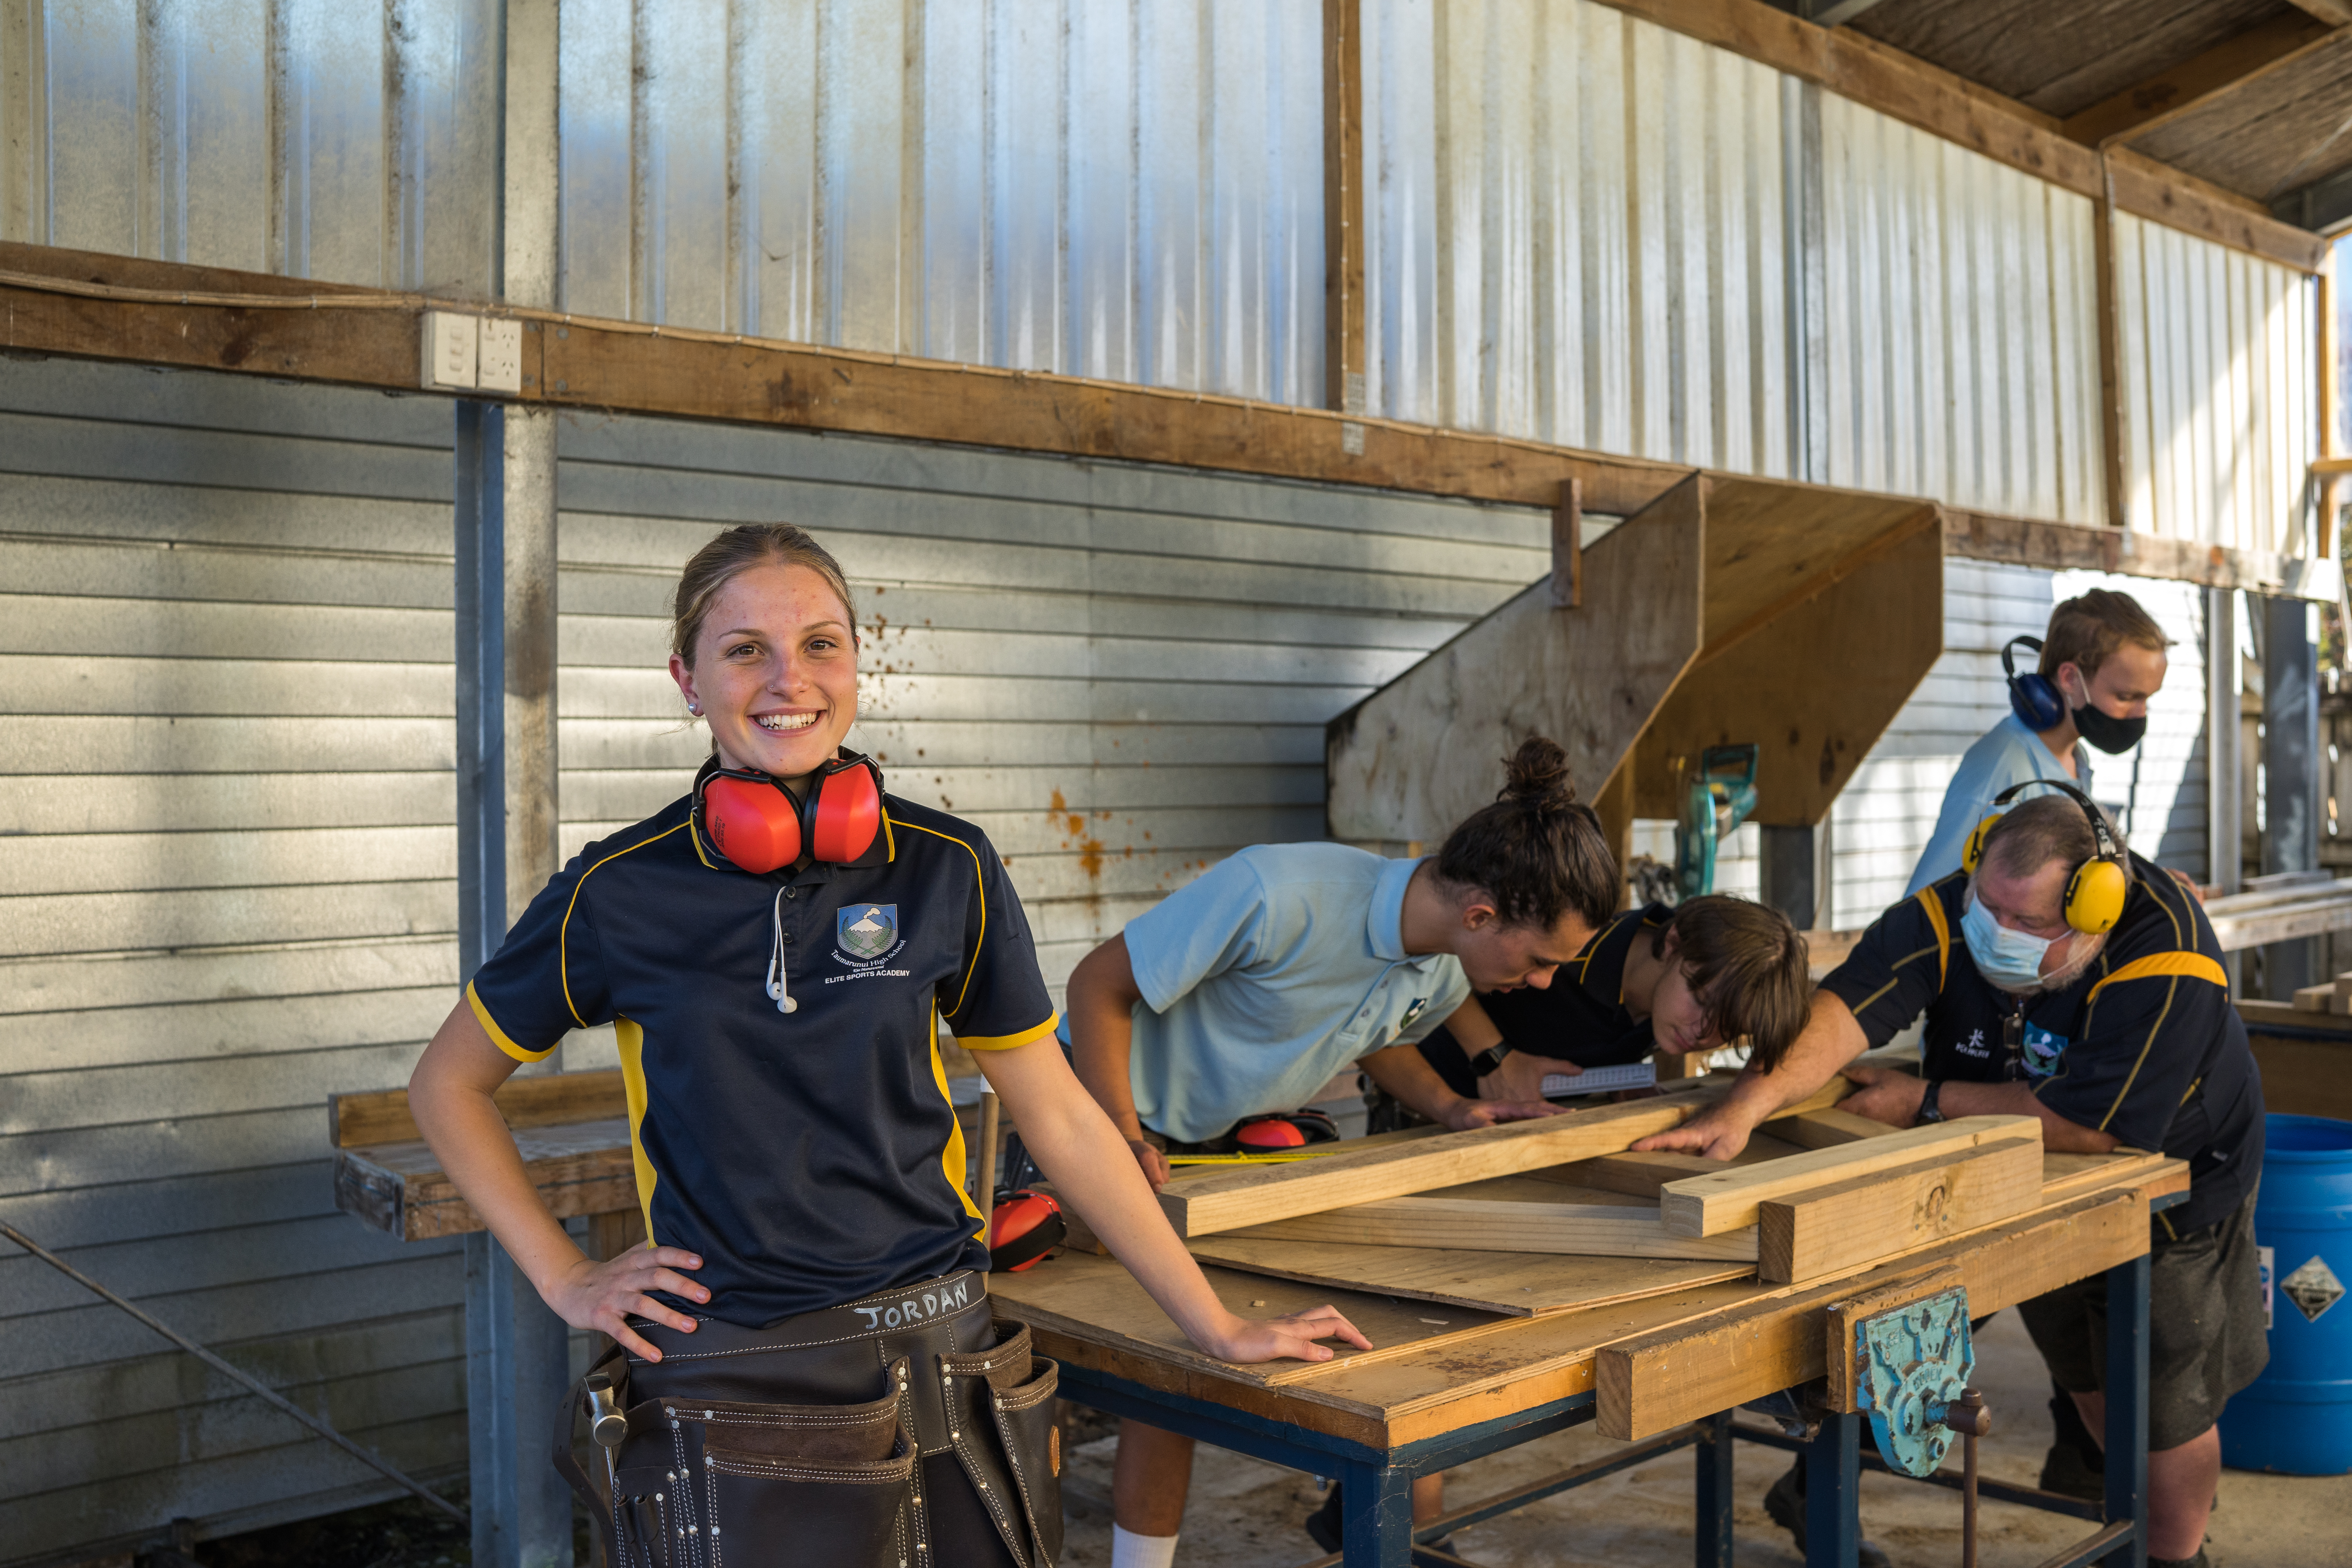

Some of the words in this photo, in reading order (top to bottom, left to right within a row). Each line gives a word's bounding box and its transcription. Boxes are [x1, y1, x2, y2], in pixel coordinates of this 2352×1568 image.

[831, 949, 869, 967] Taumarunui
[870, 957, 889, 966] High
[887, 940, 906, 959] School
[825, 976, 845, 984] ELITE
[846, 971, 875, 980] SPORTS
[853, 1282, 968, 1330] JORDAN
